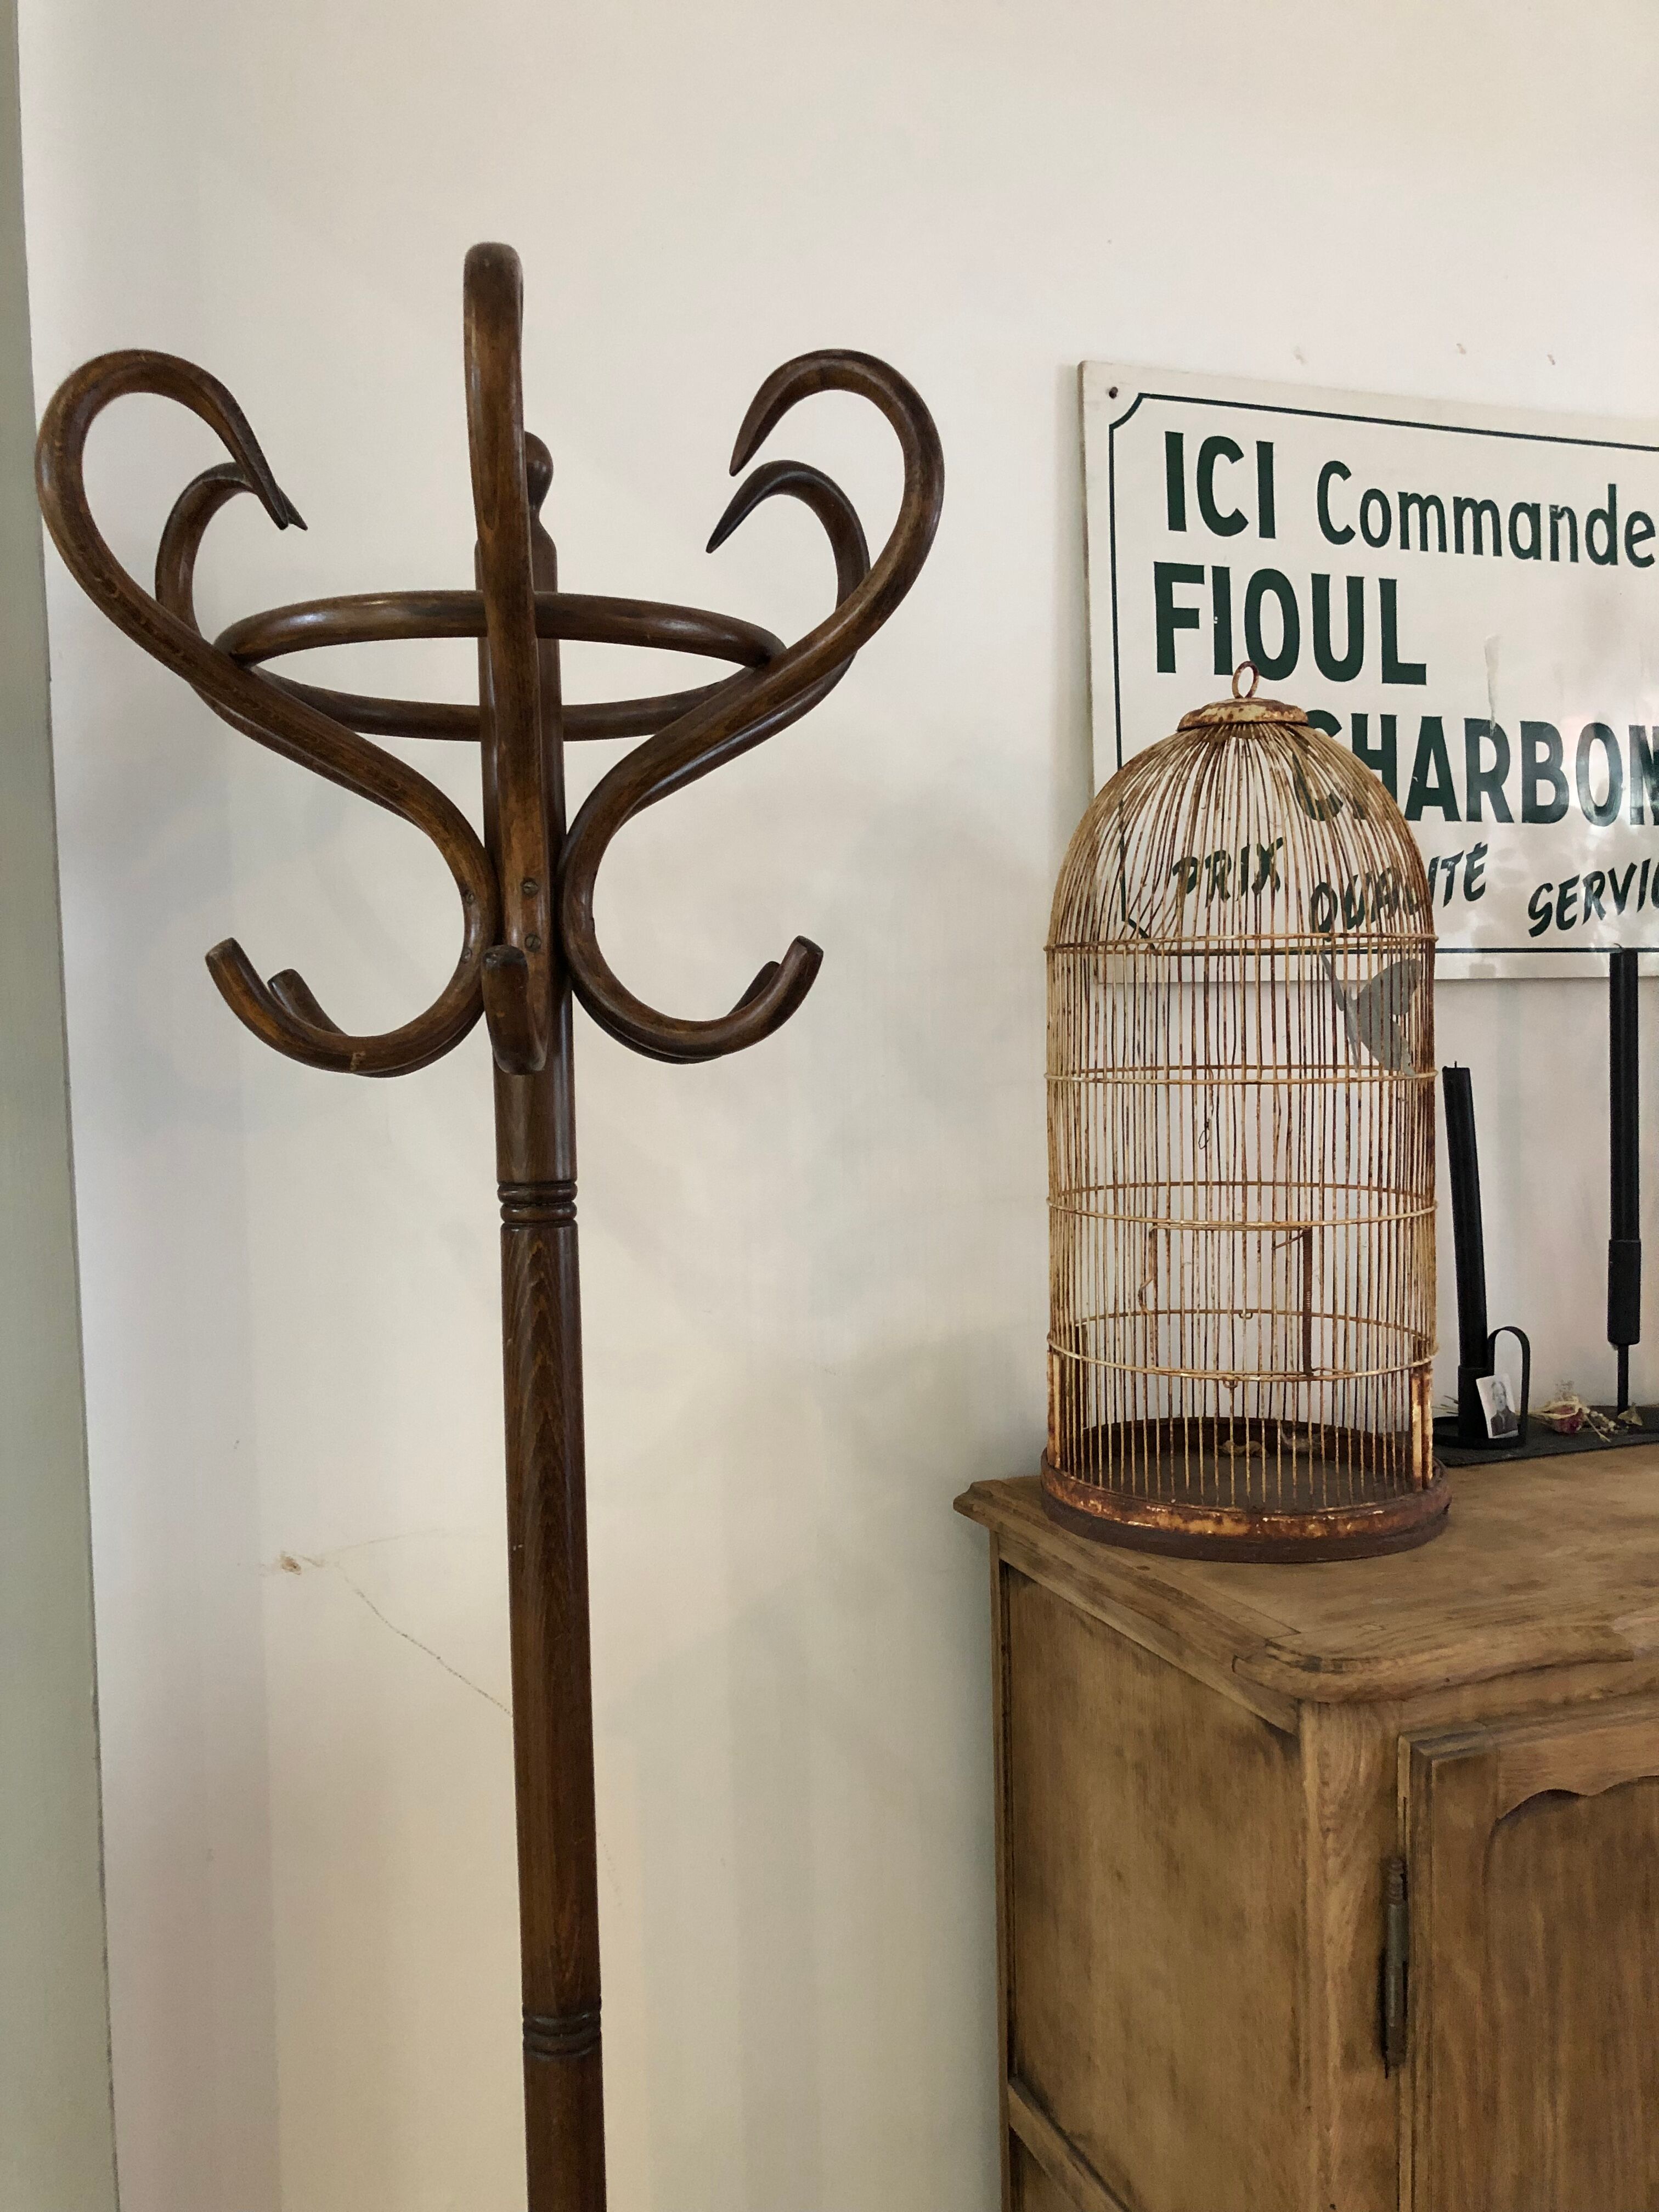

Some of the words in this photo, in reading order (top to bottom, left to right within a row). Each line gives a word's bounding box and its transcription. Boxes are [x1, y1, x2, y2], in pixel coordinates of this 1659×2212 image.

[1164, 431, 1277, 539] ICI
[1316, 460, 1656, 568] Commande
[1153, 561, 1427, 686] FIOUL
[1172, 837, 1284, 909] PRIX
